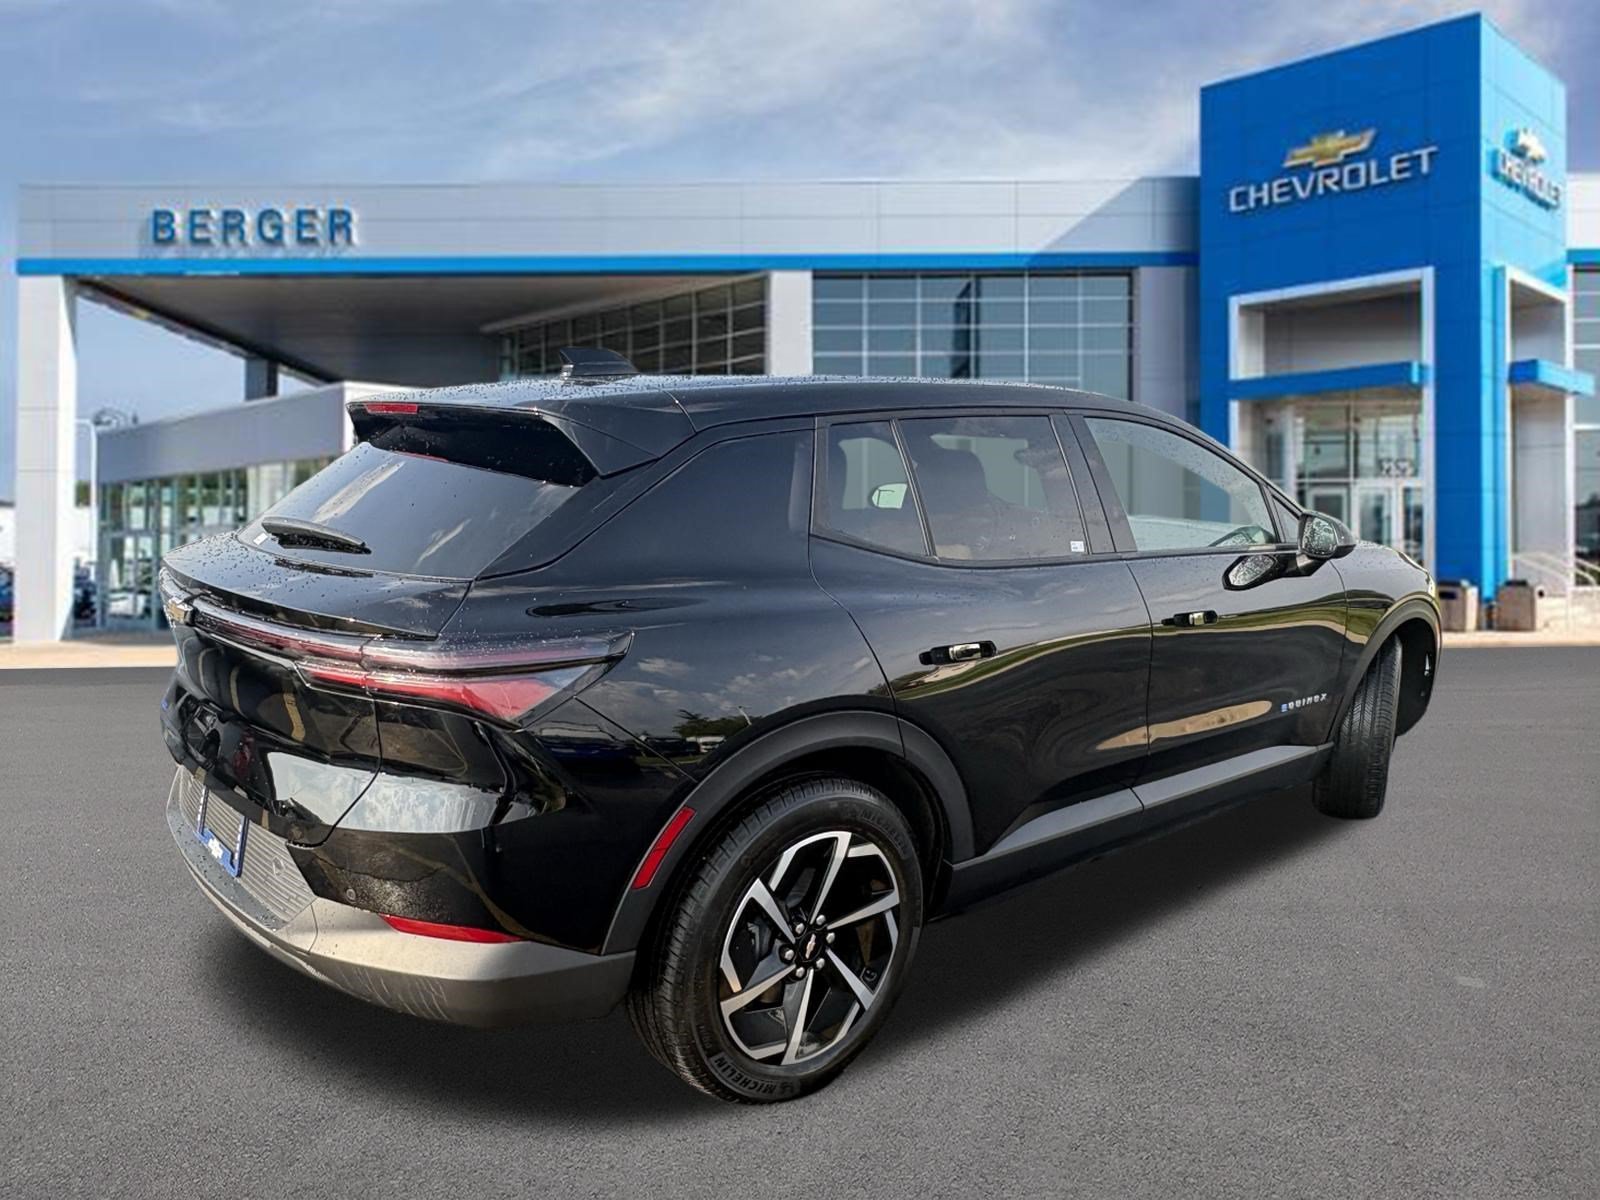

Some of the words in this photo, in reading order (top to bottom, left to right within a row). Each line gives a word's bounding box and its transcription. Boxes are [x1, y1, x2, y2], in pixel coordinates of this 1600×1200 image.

[1229, 146, 1438, 213] CHEVROLET
[152, 208, 354, 246] BERGER
[1281, 693, 1327, 713] EQUINOX
[714, 1056, 778, 1095] MICHELIN
